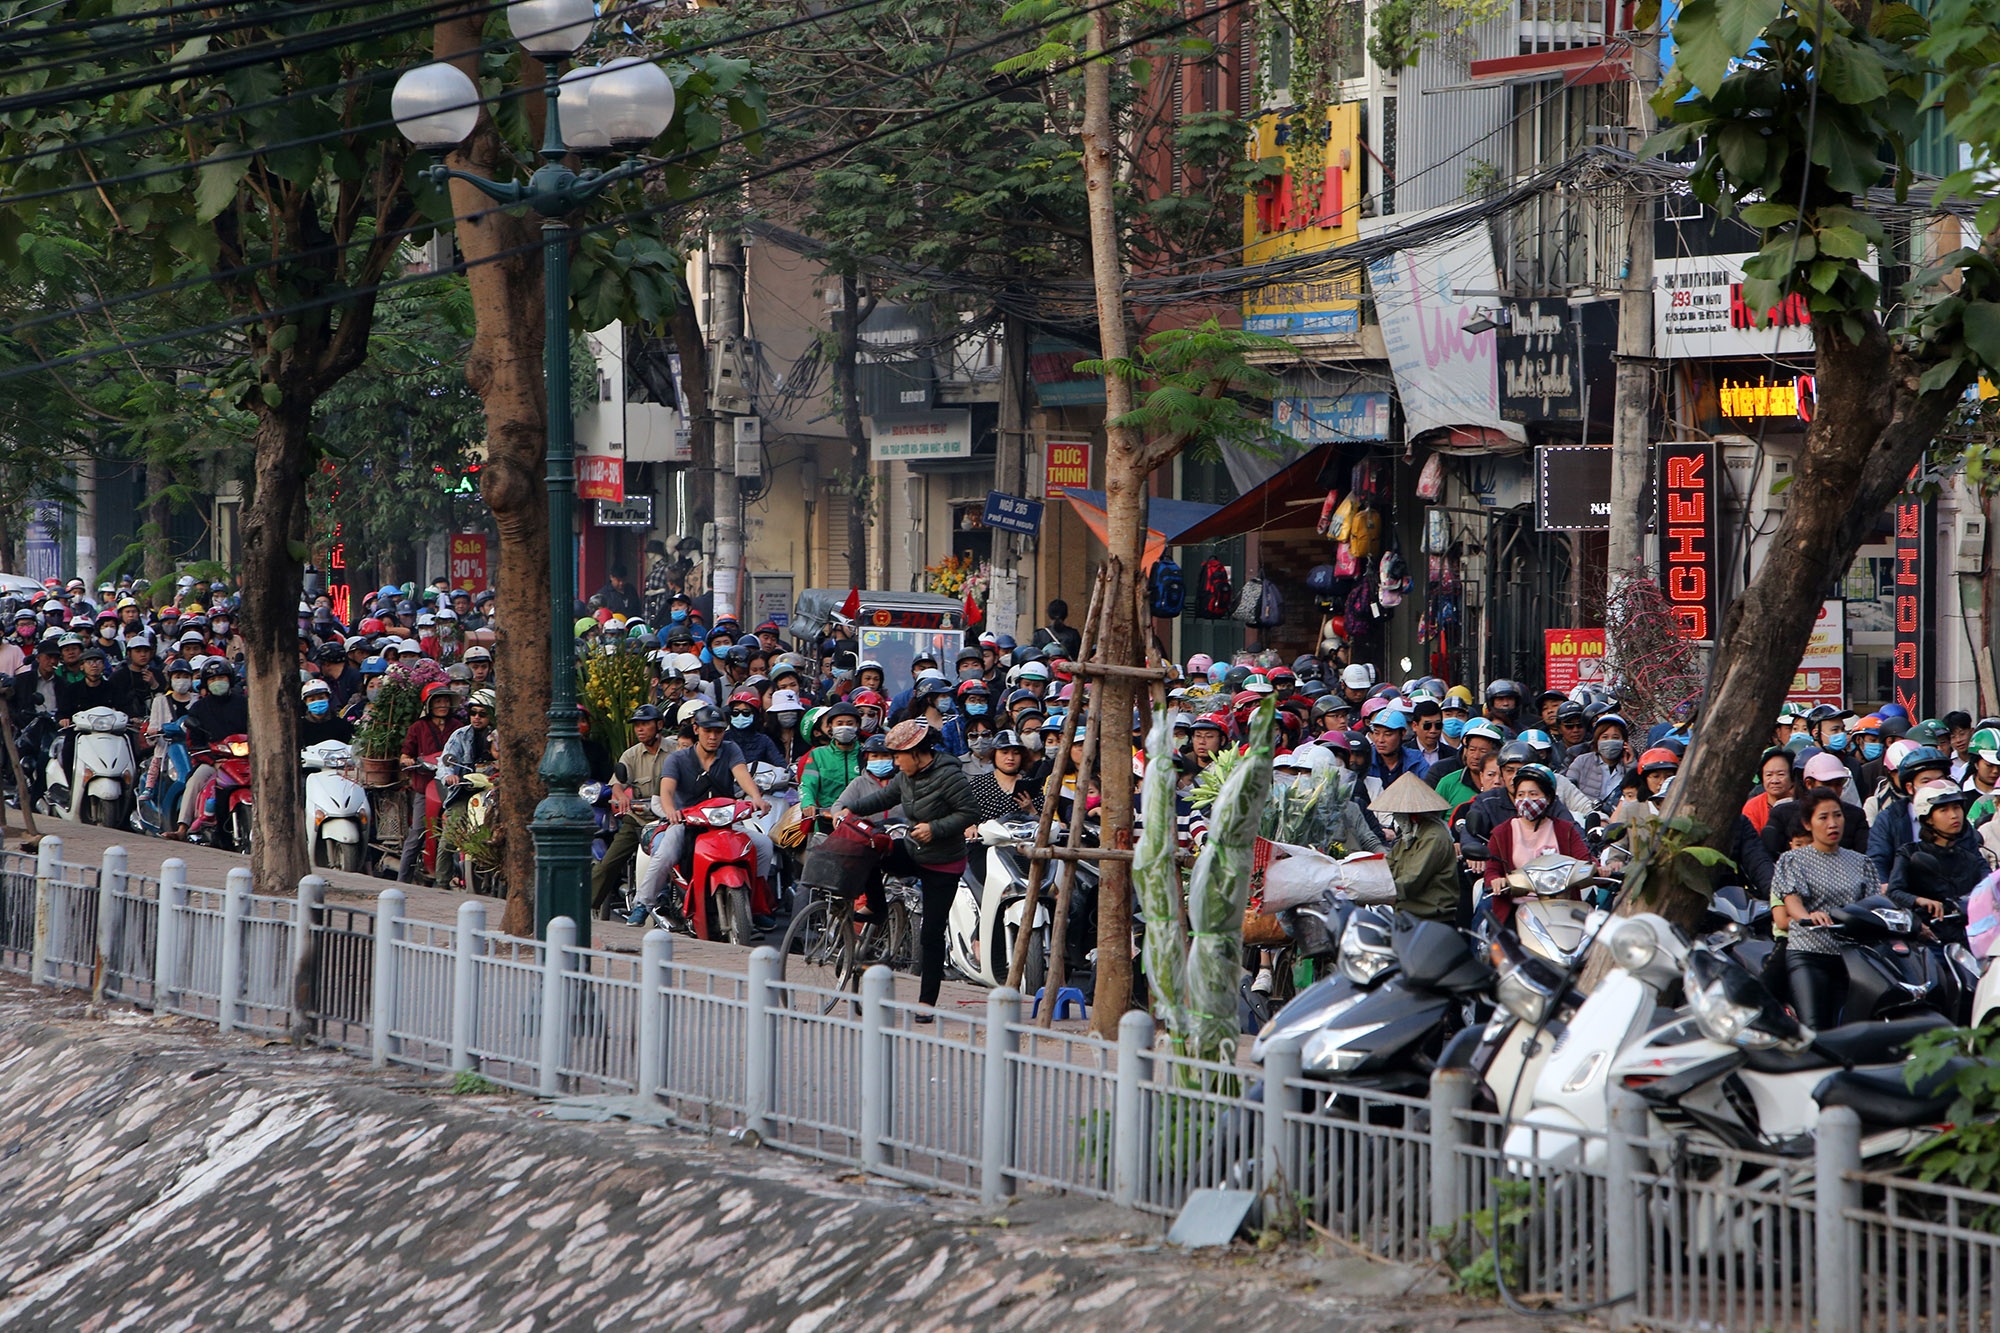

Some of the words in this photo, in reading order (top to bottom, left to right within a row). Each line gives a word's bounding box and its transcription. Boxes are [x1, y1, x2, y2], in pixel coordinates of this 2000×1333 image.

[1672, 291, 1691, 307] 293
[1053, 446, 1082, 465] ĐỨC
[1048, 467, 1087, 487] THỊNH
[998, 498, 1014, 512] NGÕ
[1590, 502, 1612, 515] NH
[987, 512, 1002, 522] PHỐ
[454, 539, 482, 554] Sale
[453, 559, 483, 578] 30%
[1550, 634, 1577, 656] NỐI
[1580, 641, 1603, 656] MI
